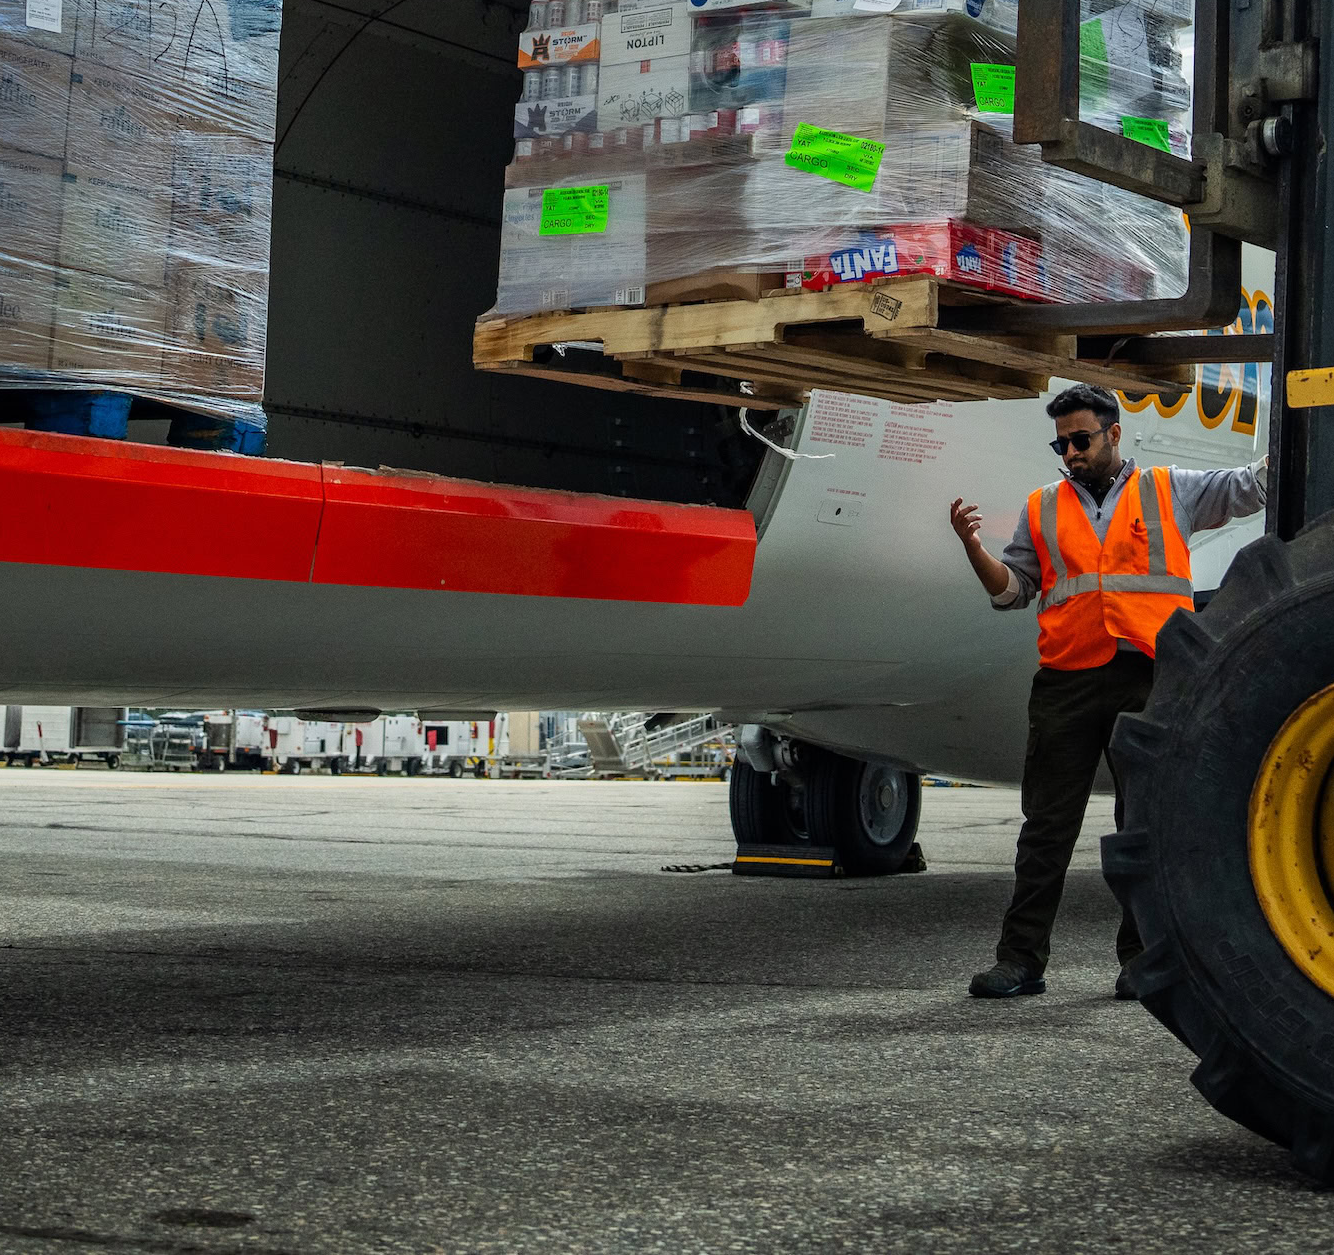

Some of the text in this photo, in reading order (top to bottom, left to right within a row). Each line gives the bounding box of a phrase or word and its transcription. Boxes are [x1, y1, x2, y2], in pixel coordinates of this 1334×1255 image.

[552, 36, 583, 46] STORM
[627, 35, 665, 50] LIPTON
[979, 96, 1005, 107] CARGO
[549, 108, 581, 117] STORM
[797, 138, 811, 147] YAT
[789, 150, 860, 173] CARGO SEC
[843, 173, 858, 181] DRY
[543, 218, 572, 229] CARGO
[832, 245, 899, 281] FANTA
[956, 253, 982, 274] FANTA
